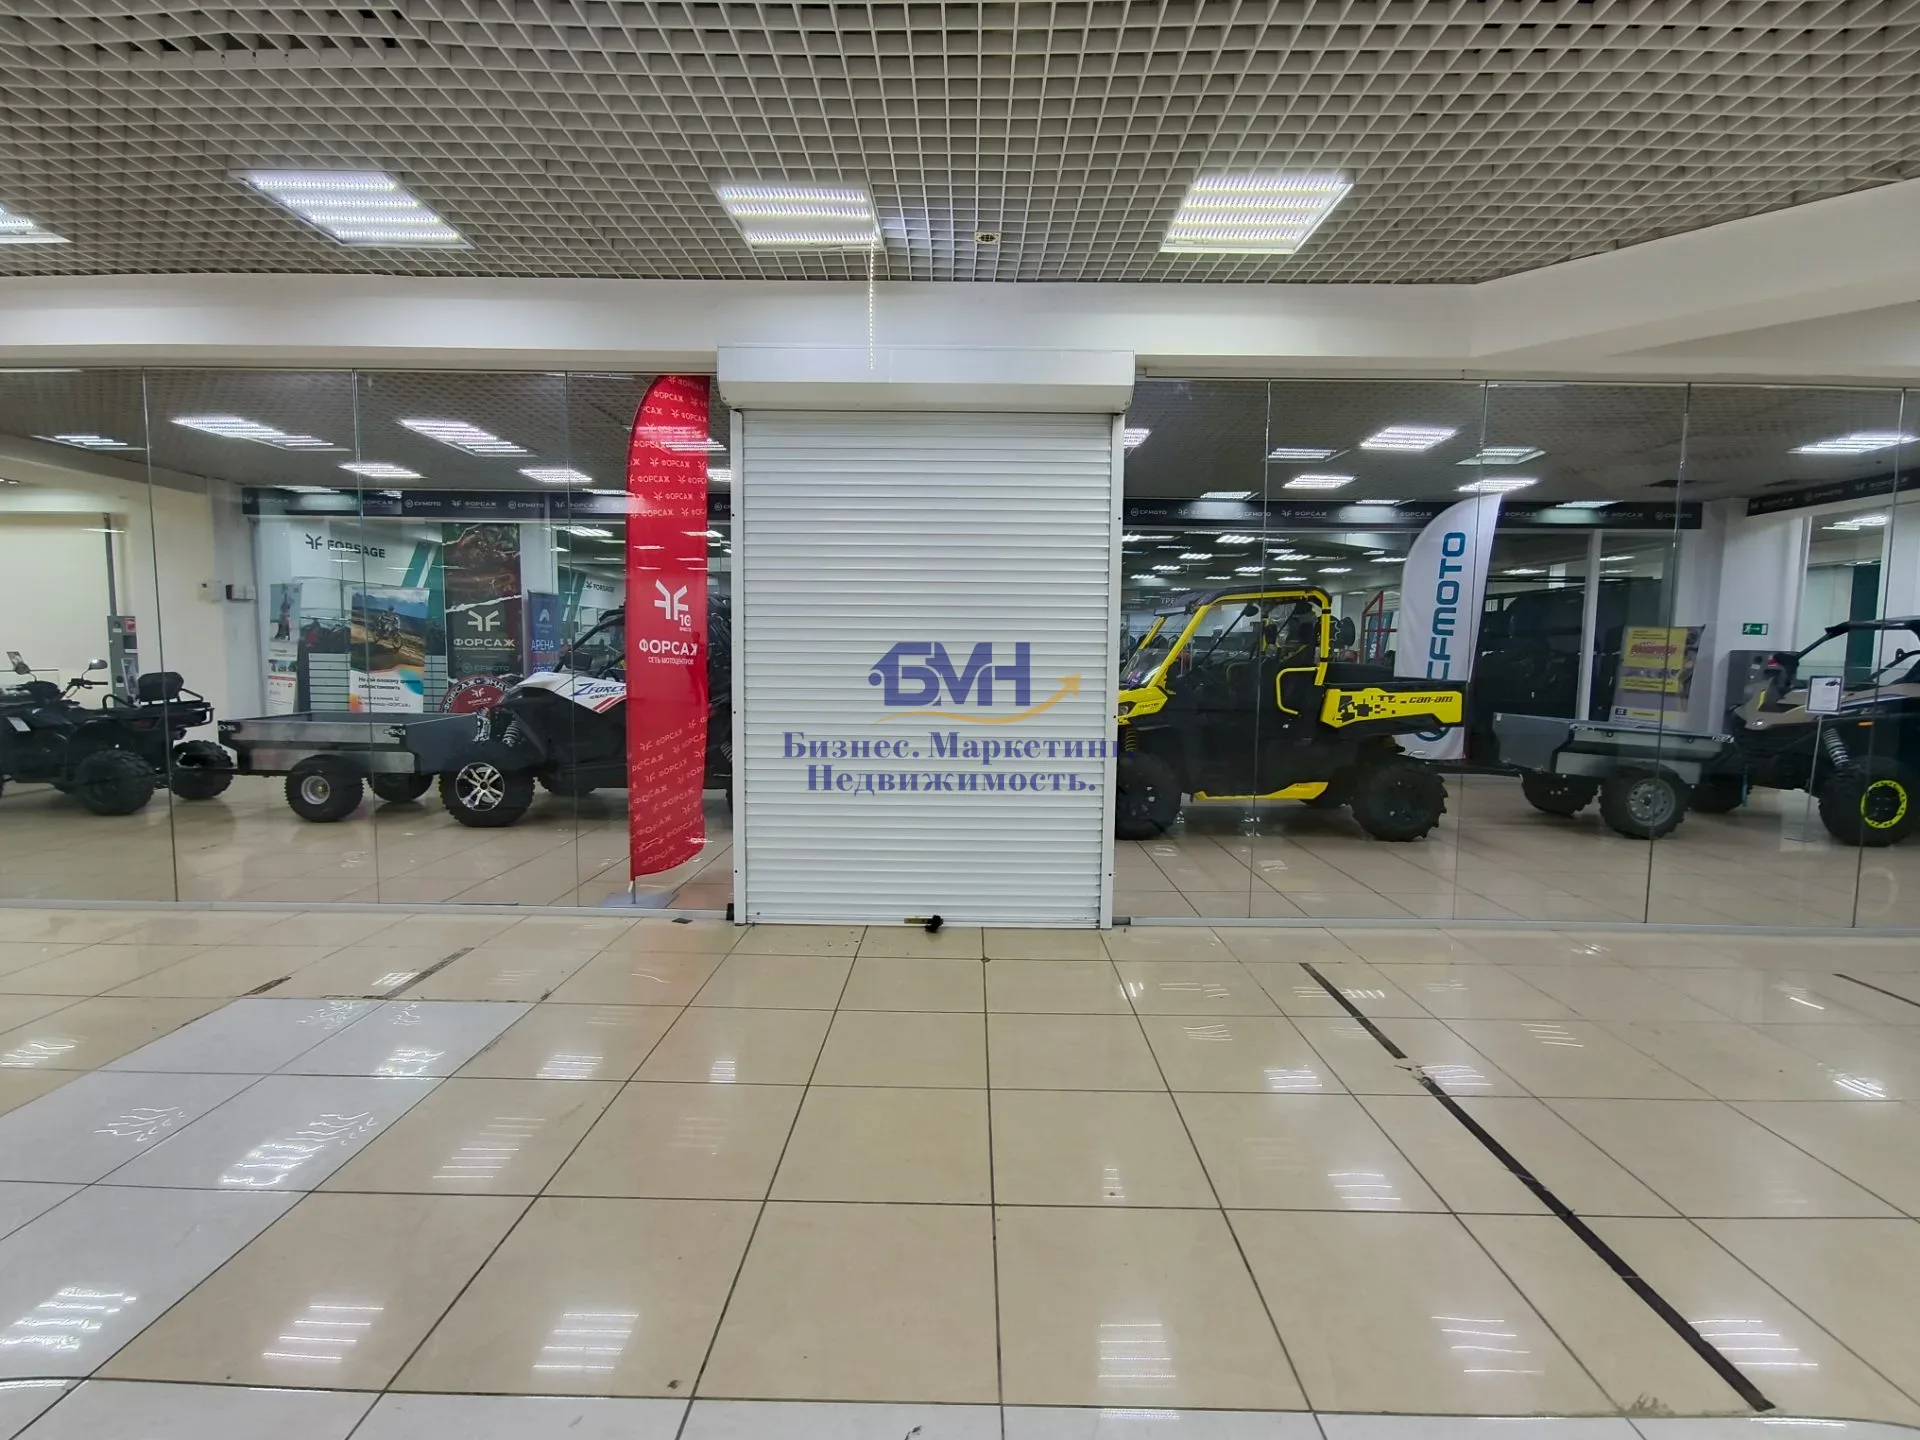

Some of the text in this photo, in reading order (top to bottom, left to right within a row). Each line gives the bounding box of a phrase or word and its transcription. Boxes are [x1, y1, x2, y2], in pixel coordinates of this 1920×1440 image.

[327, 539, 386, 558] FORSAGE
[1426, 531, 1467, 680] CFMOTO
[453, 638, 516, 647] ФОРСАЖ
[531, 639, 555, 650] АРЕНА
[1408, 695, 1453, 704] can-am
